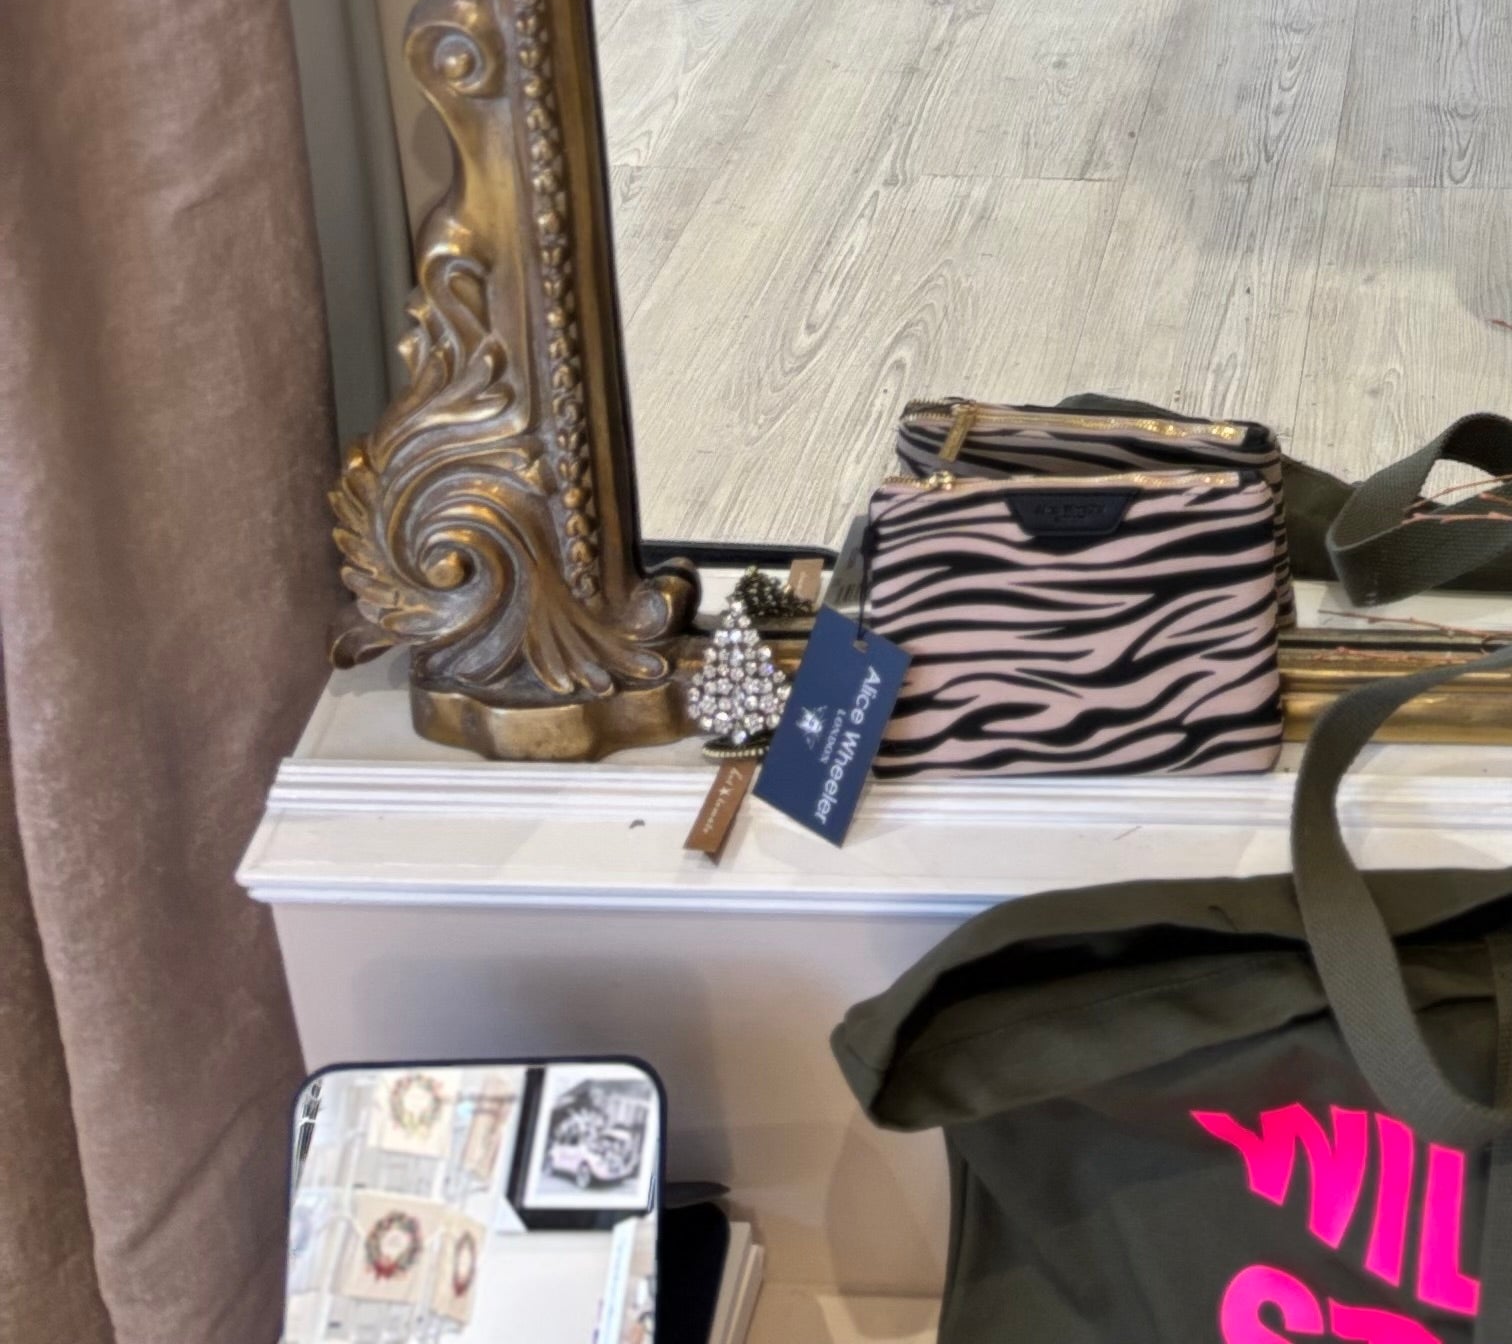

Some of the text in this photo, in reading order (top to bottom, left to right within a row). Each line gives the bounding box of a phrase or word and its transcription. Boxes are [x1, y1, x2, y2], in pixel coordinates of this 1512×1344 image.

[814, 665, 881, 825] Alice Wheeler
[820, 708, 847, 764] LONDON
